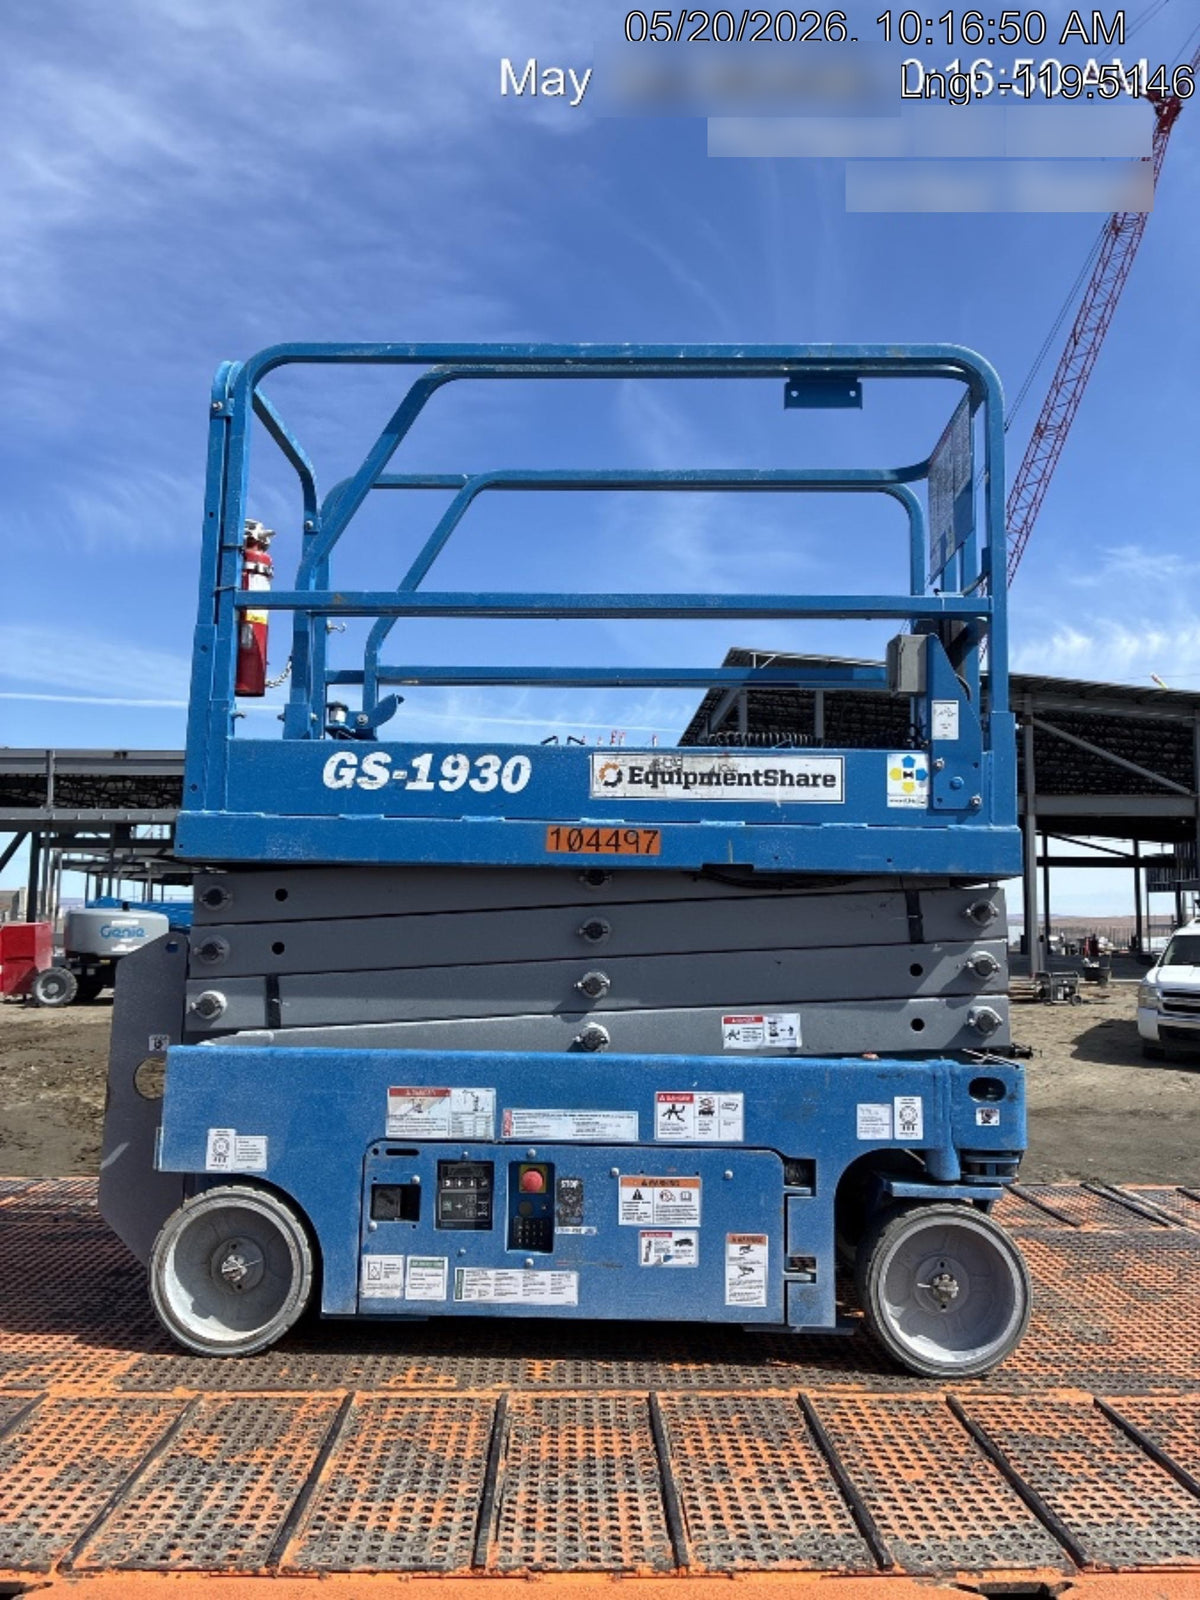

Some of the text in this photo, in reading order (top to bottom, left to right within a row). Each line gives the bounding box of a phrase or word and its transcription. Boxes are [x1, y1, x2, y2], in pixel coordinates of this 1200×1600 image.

[322, 751, 533, 794] GS-1930
[628, 766, 837, 790] EquipmentShare
[550, 827, 660, 854] 104497
[100, 925, 145, 939] Genie
